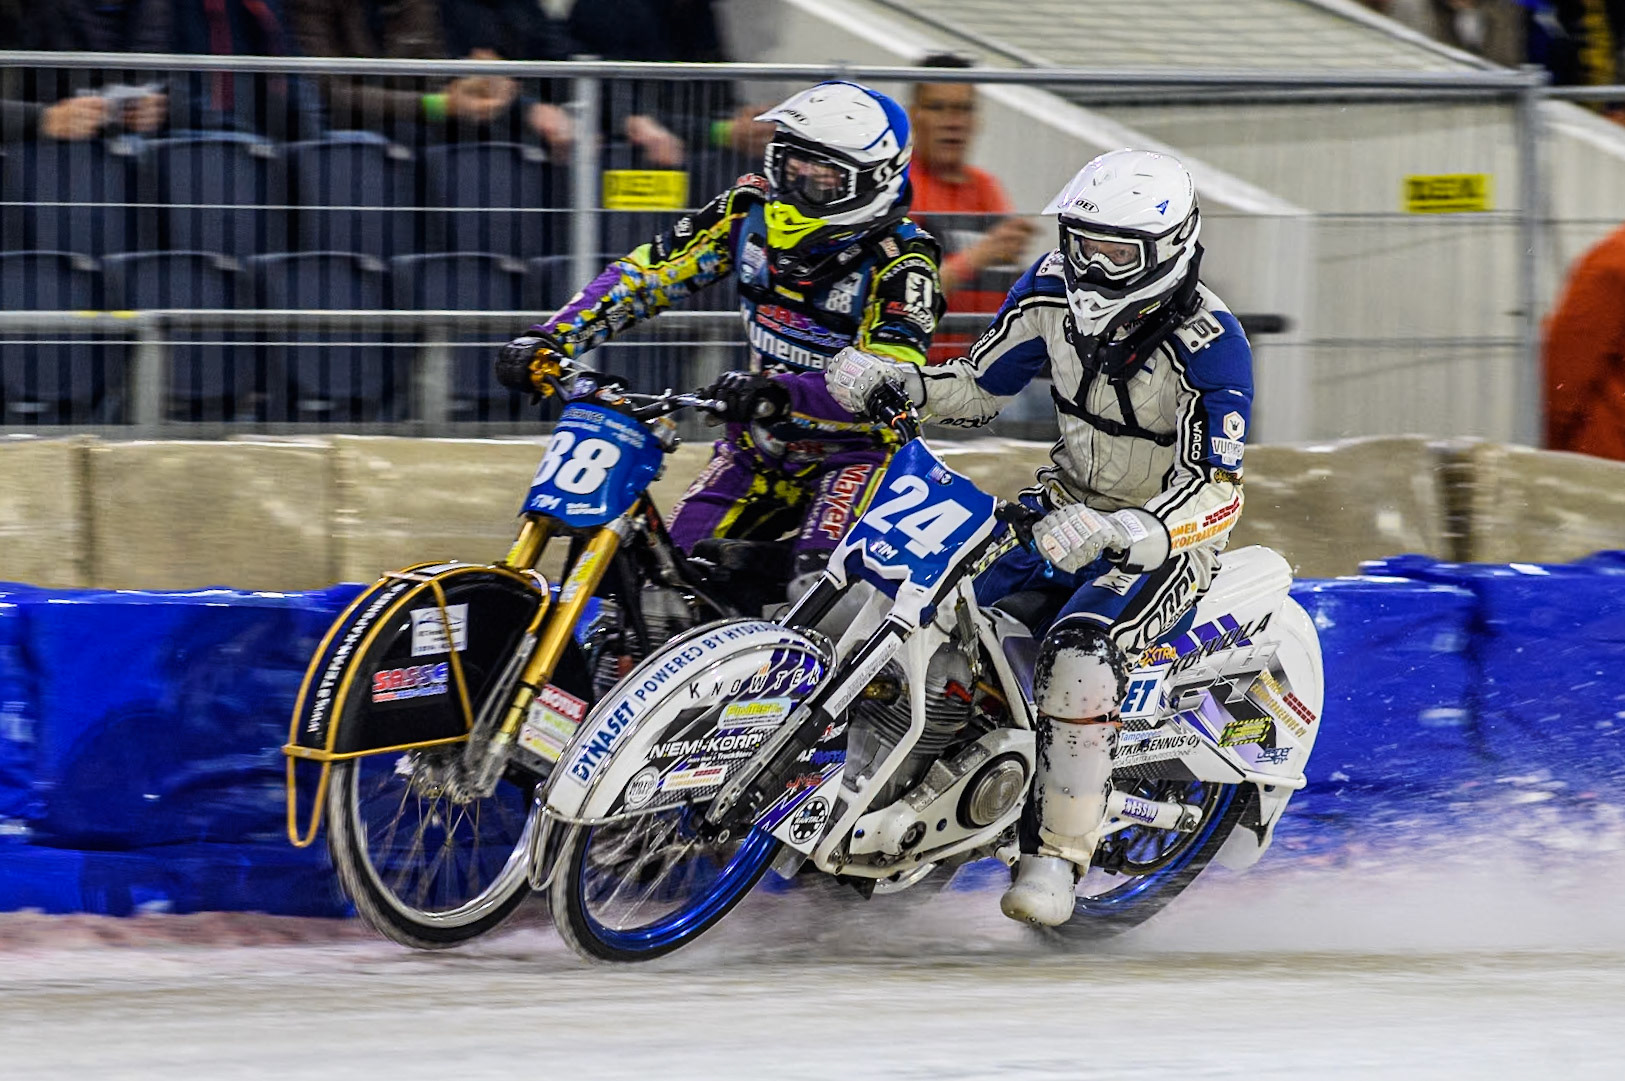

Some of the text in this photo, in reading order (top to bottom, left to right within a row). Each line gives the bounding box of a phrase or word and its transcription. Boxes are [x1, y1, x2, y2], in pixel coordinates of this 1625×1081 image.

[531, 431, 622, 495] 88
[1191, 421, 1202, 461] WACO
[819, 464, 874, 541] Mayer
[862, 474, 974, 559] 24
[871, 540, 899, 560] FIM
[572, 701, 636, 782] DYNASET
[635, 645, 704, 702] POWERED
[702, 633, 726, 651] BY
[689, 666, 820, 700] KNOWTEK
[1120, 679, 1158, 713] ET
